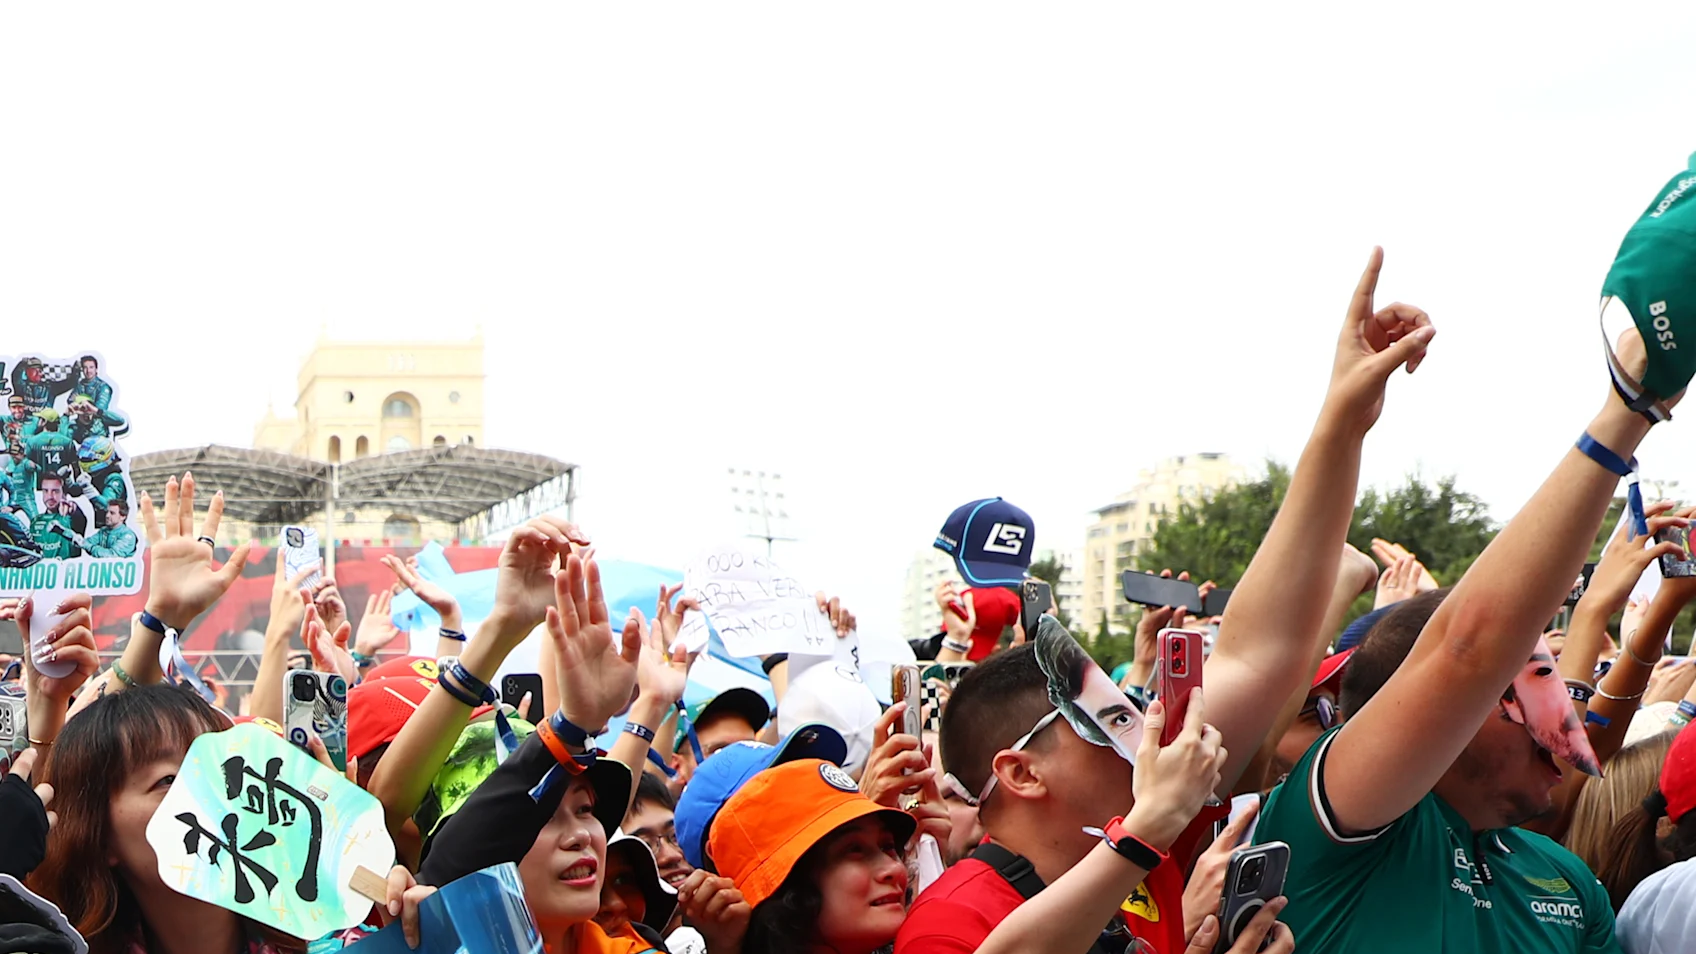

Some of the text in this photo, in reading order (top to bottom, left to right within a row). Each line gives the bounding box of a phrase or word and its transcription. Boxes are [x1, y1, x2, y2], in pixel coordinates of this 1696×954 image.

[1649, 301, 1677, 351] BOSS
[45, 452, 62, 465] 14
[64, 561, 136, 590] ALONSO
